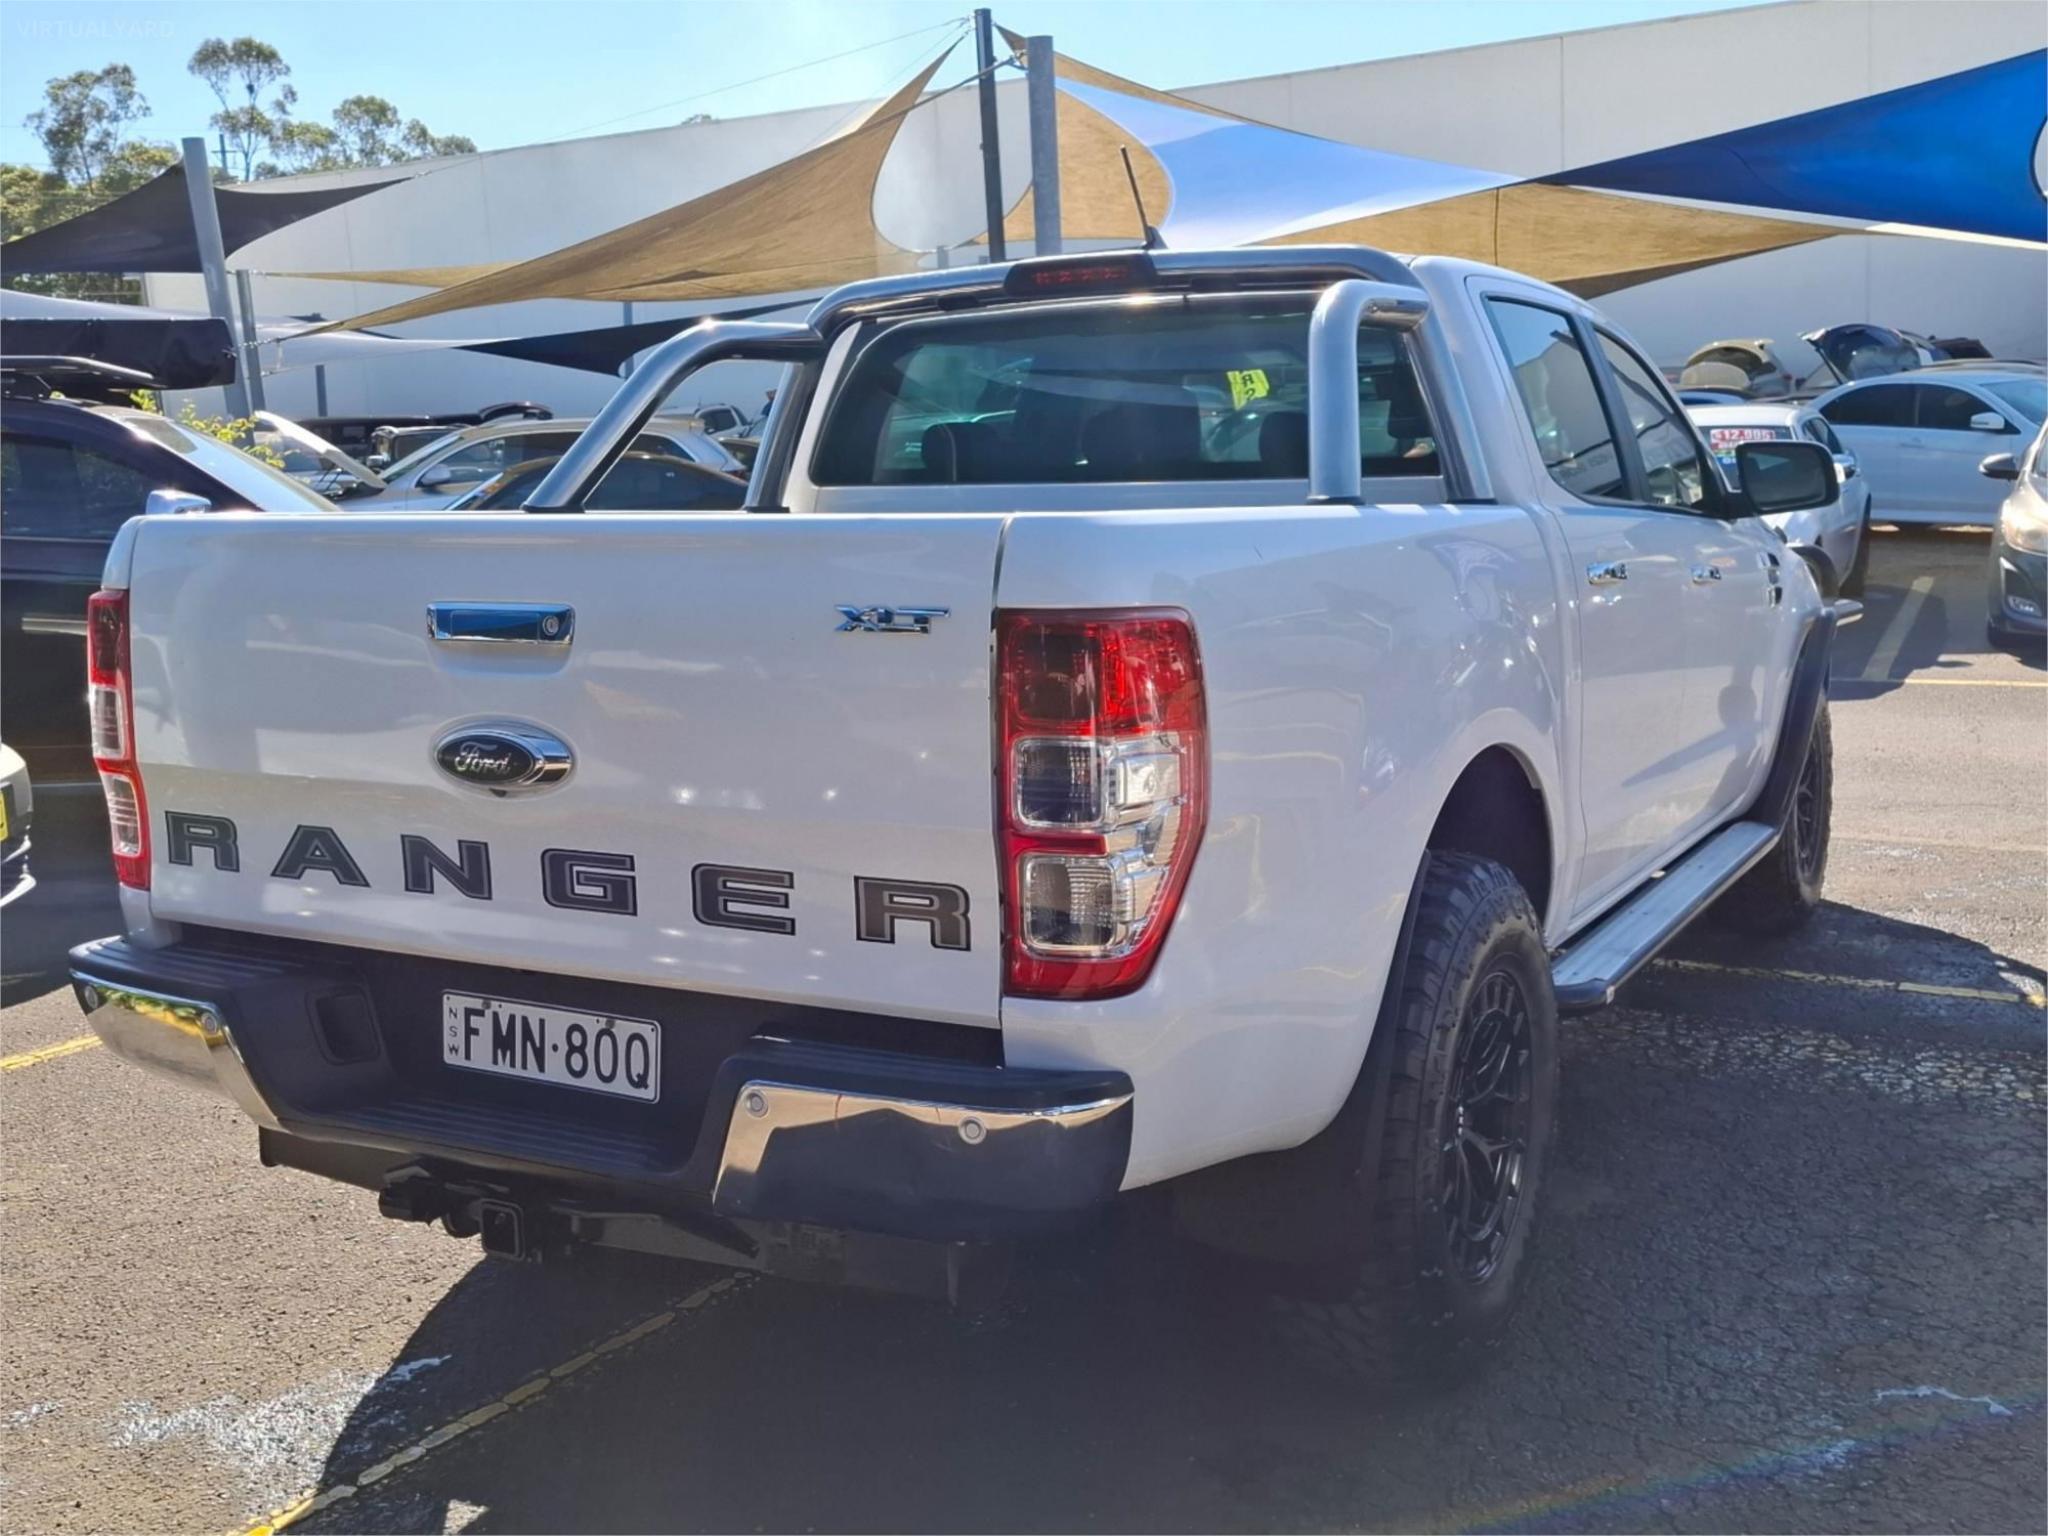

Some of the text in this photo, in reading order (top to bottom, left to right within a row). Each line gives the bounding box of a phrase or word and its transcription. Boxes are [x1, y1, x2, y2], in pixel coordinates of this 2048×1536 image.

[835, 604, 951, 633] XLT
[454, 741, 512, 773] Ford
[164, 810, 972, 952] RANGER
